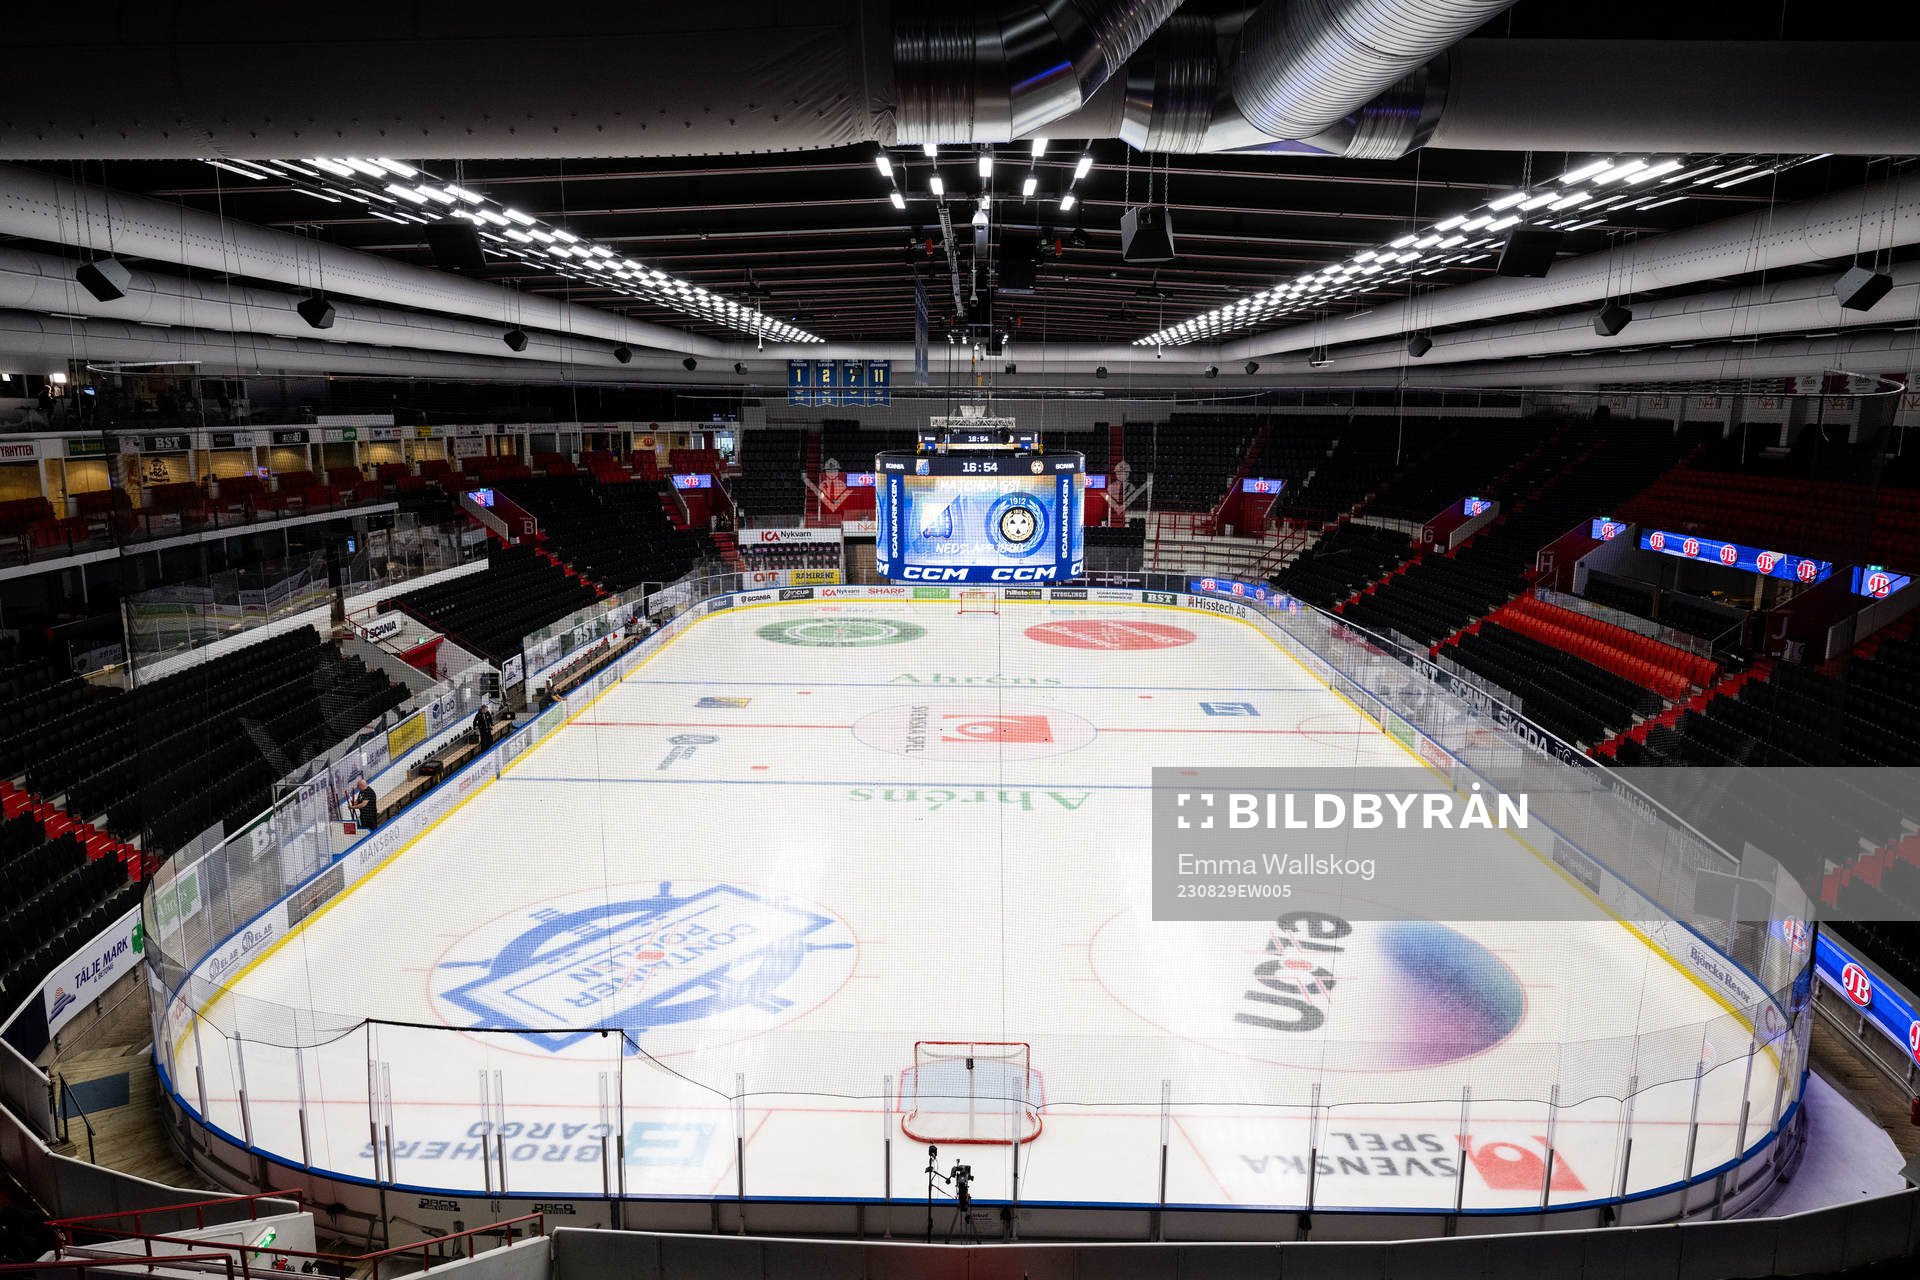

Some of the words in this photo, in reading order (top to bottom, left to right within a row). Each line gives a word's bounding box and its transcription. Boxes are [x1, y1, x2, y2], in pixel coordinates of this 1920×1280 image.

[797, 369, 801, 382] 1
[823, 369, 830, 382] 2
[875, 369, 884, 382] 11
[155, 438, 182, 448] BST
[963, 462, 998, 472] 16:54
[761, 531, 780, 542] ICA
[780, 530, 812, 539] Nykvarn
[1651, 534, 1664, 549] JB
[1684, 540, 1698, 556] JB
[1721, 547, 1737, 563] JB
[1758, 555, 1774, 572] JB
[903, 566, 969, 580] CCM
[991, 566, 1057, 580] CCM
[1798, 563, 1816, 581] JB
[822, 588, 837, 597] ICA
[867, 588, 905, 596] SHARP
[1870, 575, 1890, 595] JB
[1147, 593, 1172, 604] BST
[1195, 596, 1233, 616] Hisstech
[1236, 606, 1246, 618] AB
[369, 620, 397, 640] SCANIA
[1412, 658, 1440, 684] BST
[1611, 781, 1657, 824] MÅNSBRO
[75, 957, 101, 989] TÄLJE
[102, 936, 128, 967] MARK
[1690, 946, 1723, 981] Björcks
[1725, 972, 1751, 1003] Resor
[1843, 965, 1870, 1003] JB
[467, 1121, 614, 1141] CARGO
[1331, 1132, 1443, 1153] SPEL
[358, 1141, 602, 1163] BROTHERS
[1241, 1154, 1459, 1178] SVENSKA
